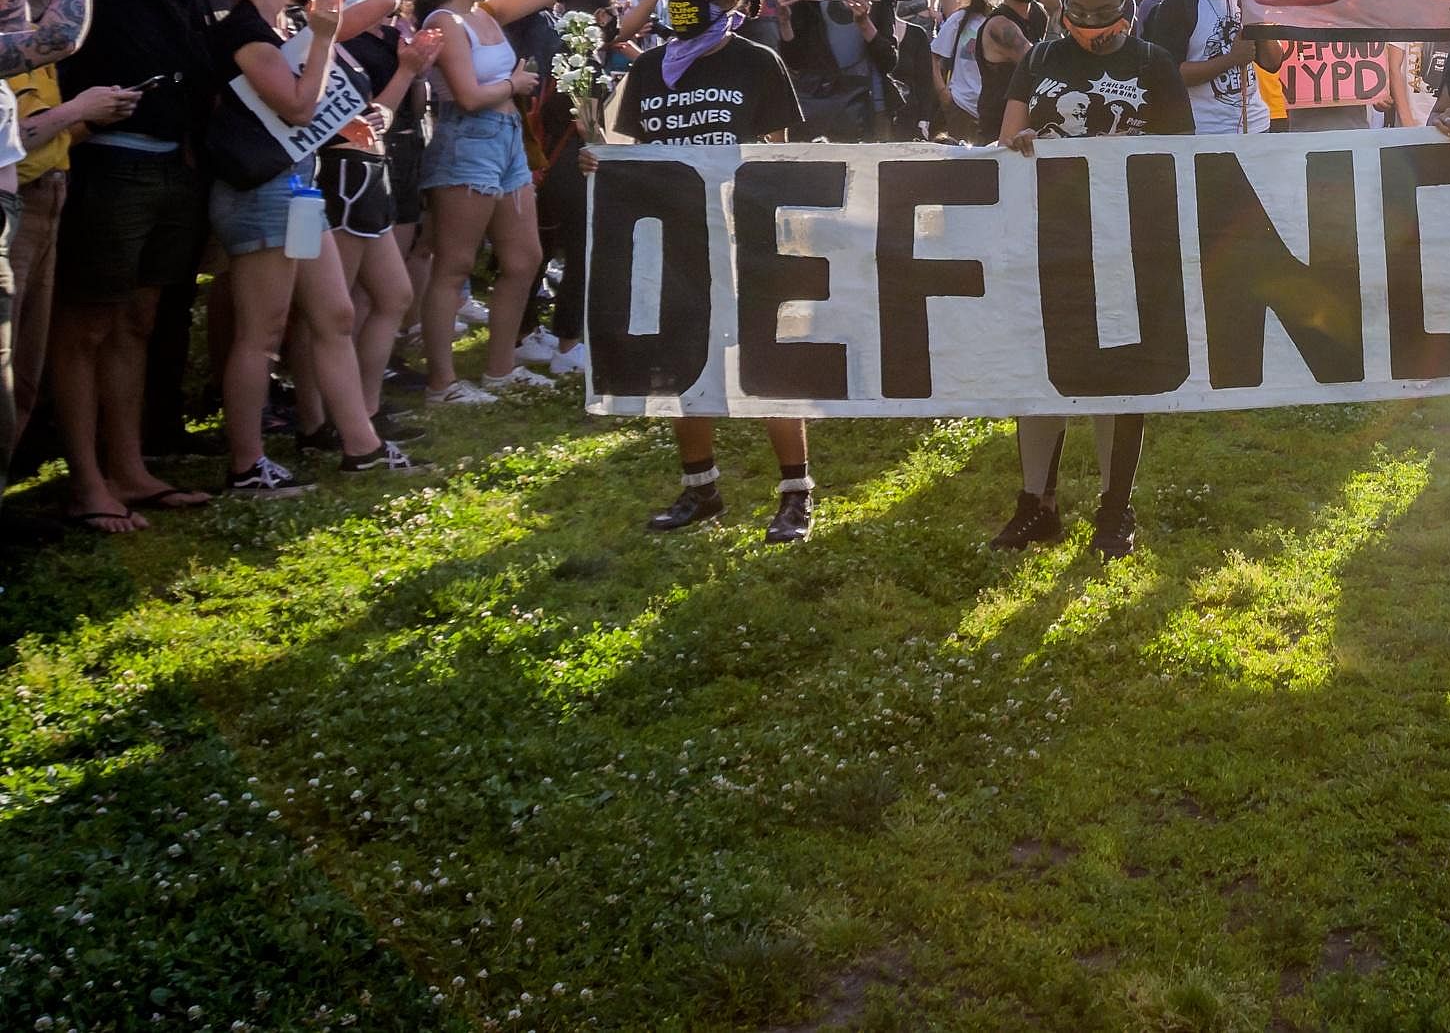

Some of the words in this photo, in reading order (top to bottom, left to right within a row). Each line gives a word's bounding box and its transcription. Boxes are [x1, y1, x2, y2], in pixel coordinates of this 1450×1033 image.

[1035, 78, 1068, 98] WE
[1100, 81, 1137, 93] CHILDISH
[1279, 60, 1386, 105] NYPD
[640, 97, 664, 113] NO
[666, 88, 744, 107] PRISONS
[1099, 87, 1138, 100] GAMBINO
[289, 90, 361, 153] MATTER
[666, 109, 732, 130] SLAVES
